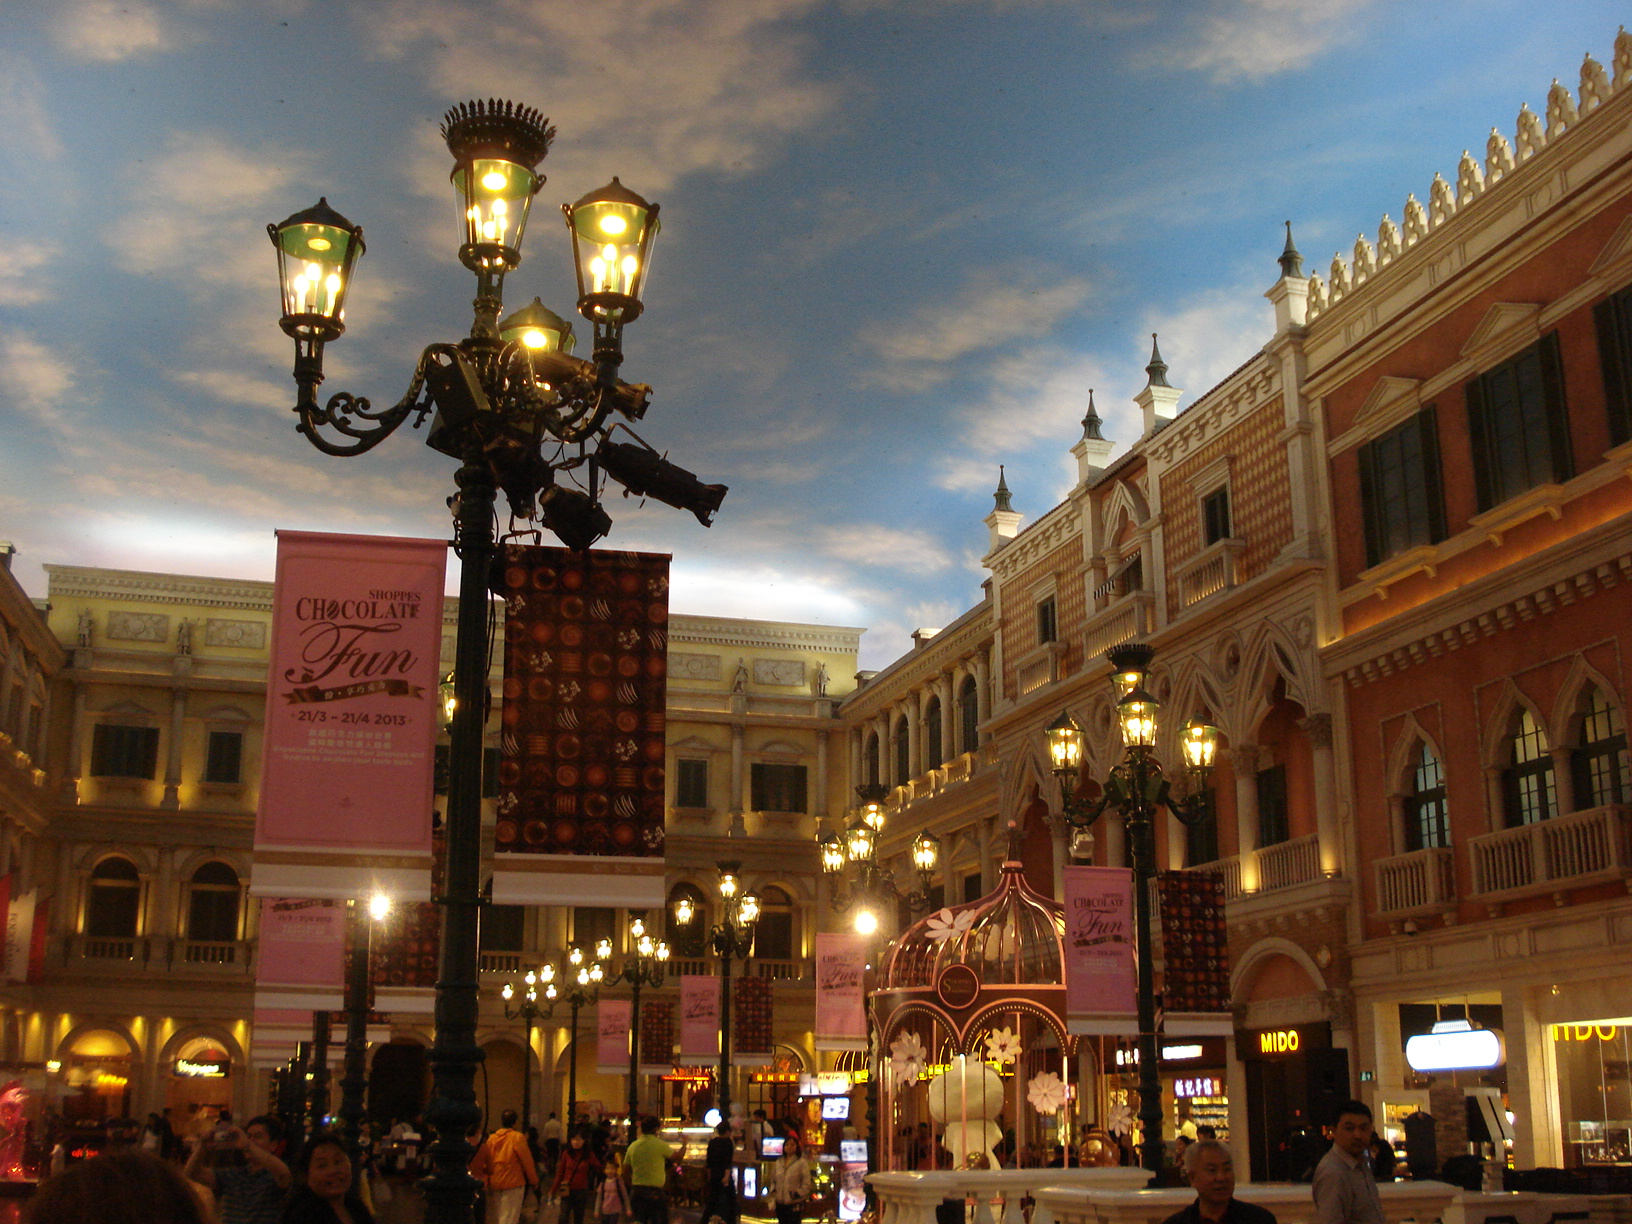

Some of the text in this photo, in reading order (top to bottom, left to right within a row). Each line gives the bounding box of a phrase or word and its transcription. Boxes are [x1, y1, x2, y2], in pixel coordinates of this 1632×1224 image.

[369, 589, 421, 602] SHOPPES
[295, 597, 421, 621] CHOCOLATE
[284, 621, 419, 684] Fun
[297, 710, 327, 723] 21/3
[341, 712, 370, 725] 21/4
[374, 713, 407, 727] 2013
[1072, 908, 1124, 939] Fun
[1261, 1030, 1299, 1053] MIDO
